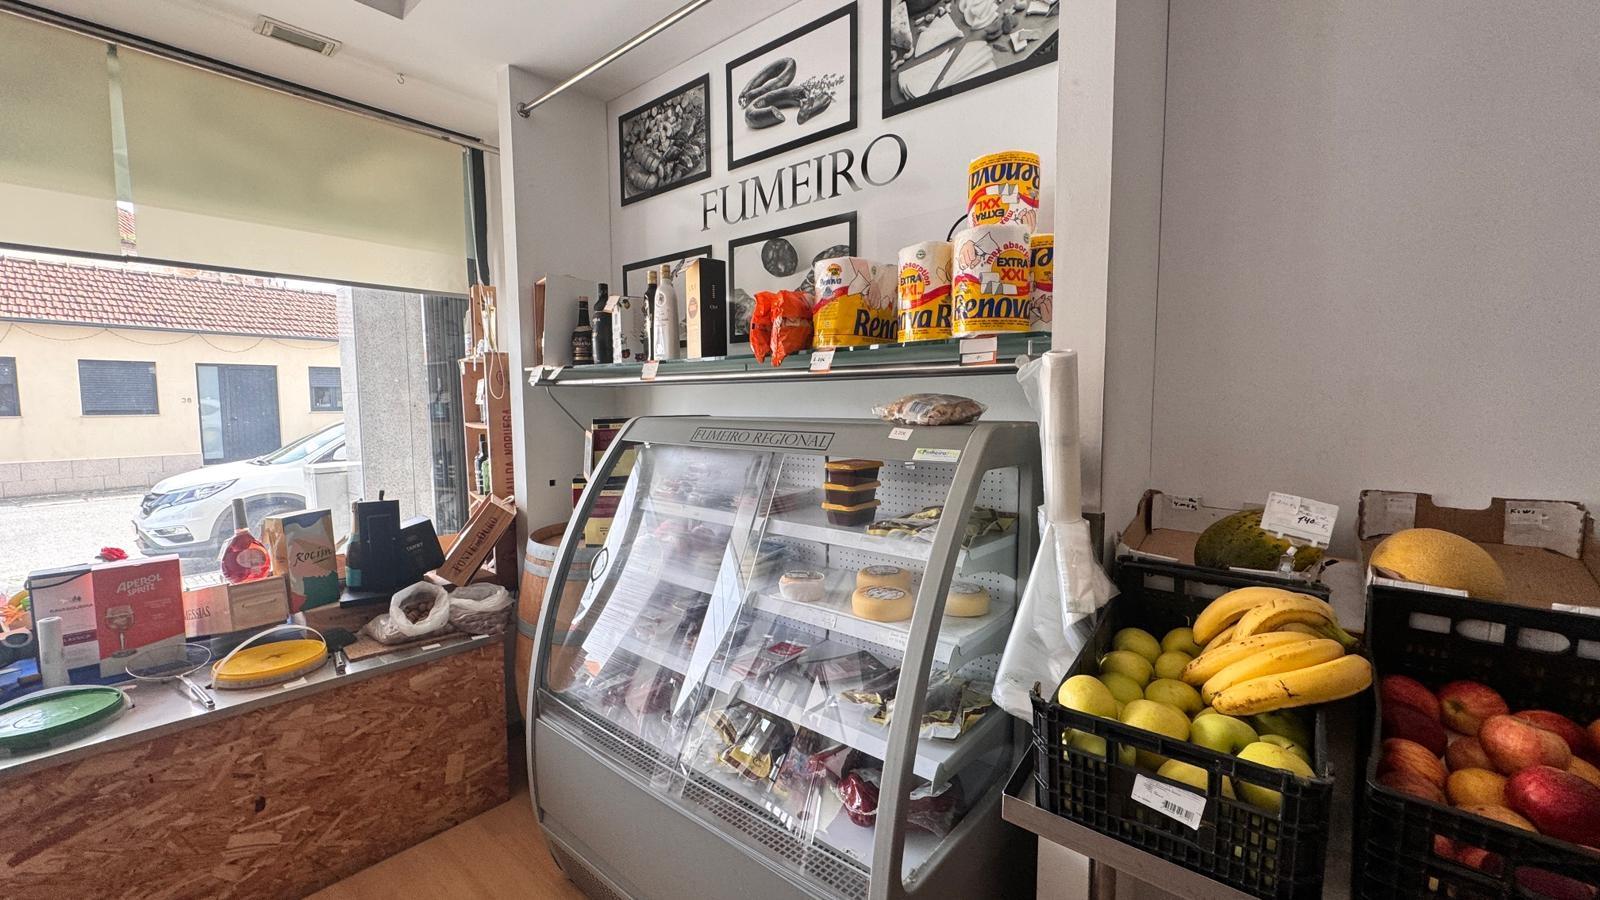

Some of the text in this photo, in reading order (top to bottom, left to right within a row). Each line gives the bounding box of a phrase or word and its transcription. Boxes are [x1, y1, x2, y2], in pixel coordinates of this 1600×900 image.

[700, 133, 908, 232] FUMEIRO
[976, 196, 1001, 210] XXL
[975, 208, 1005, 222] EXTRA
[986, 246, 1003, 265] max
[997, 256, 1028, 269] EXTRA
[1000, 267, 1028, 282] XXL
[694, 429, 827, 447] FUMEIRO REGIONAL
[116, 572, 163, 595] APEROL
[127, 583, 156, 598] SPRITZ
